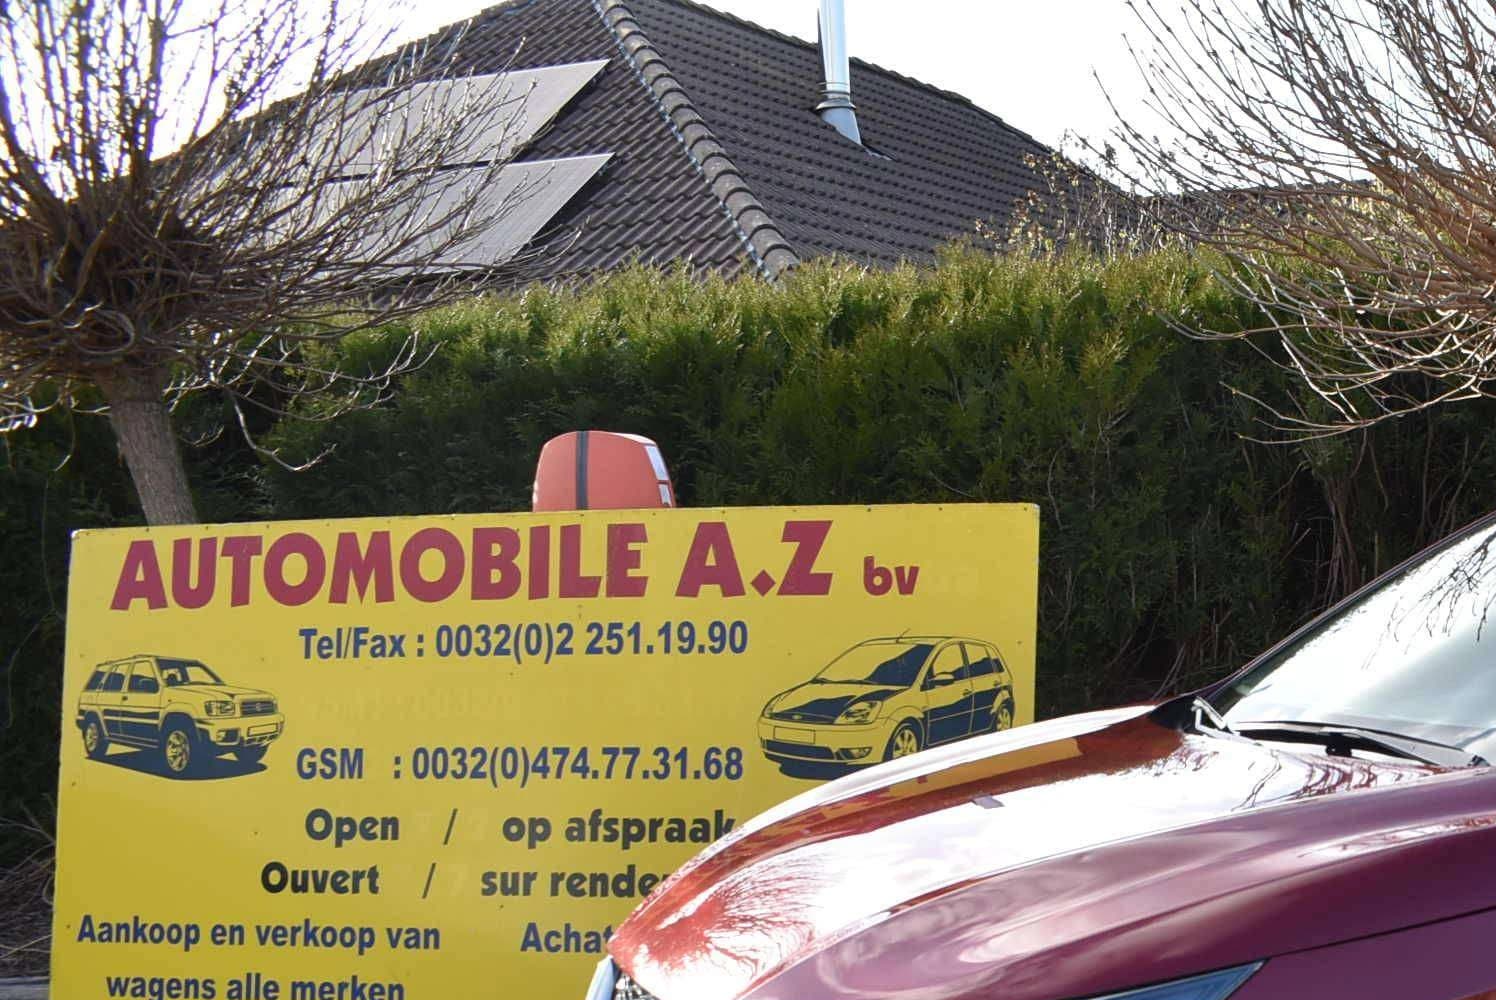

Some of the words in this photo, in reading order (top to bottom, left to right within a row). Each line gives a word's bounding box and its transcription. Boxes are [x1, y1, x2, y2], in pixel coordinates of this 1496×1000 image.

[110, 522, 649, 611] AUTOMOBILE
[675, 520, 833, 598] A.Z
[863, 556, 919, 596] bv
[299, 626, 406, 660] Tel/Fax
[435, 622, 574, 664] 0032(0)2
[585, 620, 748, 655] 251.19.90
[297, 747, 364, 780] GSM
[412, 746, 744, 788] 0032(0)474.77.31.68
[305, 808, 399, 848] Open
[443, 808, 458, 845] /
[502, 816, 552, 849] op
[261, 861, 379, 894] Ouvert
[422, 862, 436, 899] /
[481, 870, 538, 896] sur
[550, 865, 671, 898] rende
[77, 914, 200, 951] Aankoop
[210, 922, 245, 946] en
[256, 918, 375, 955] verkoop
[386, 926, 440, 950] van
